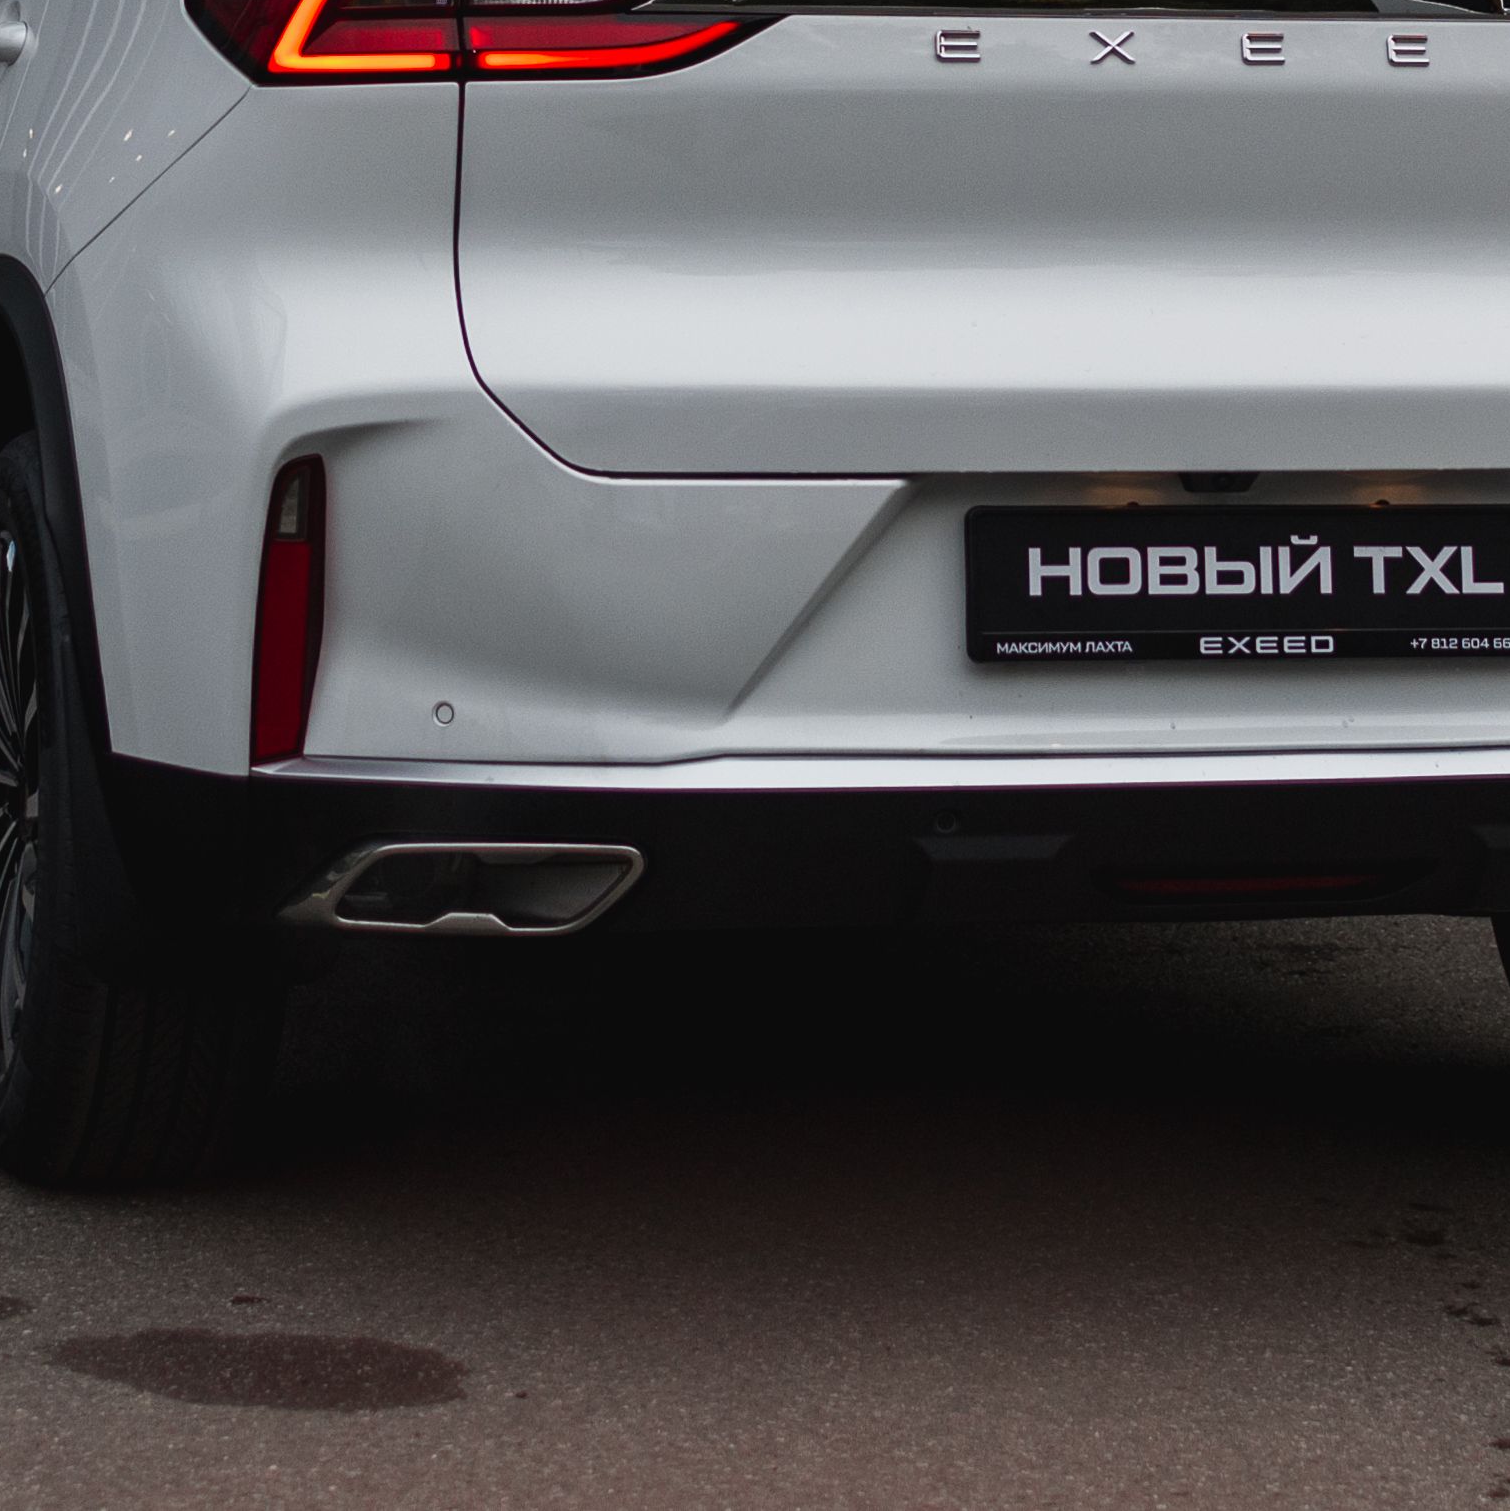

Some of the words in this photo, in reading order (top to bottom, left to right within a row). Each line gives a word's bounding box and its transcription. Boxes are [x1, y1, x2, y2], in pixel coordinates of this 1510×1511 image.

[1028, 534, 1333, 596] НОВЫЙ
[1352, 545, 1506, 594] TXL
[996, 642, 1082, 654] МАКСИМУМ
[1085, 641, 1133, 653] ЛАХТА
[1199, 636, 1334, 654] EXEED
[1410, 637, 1427, 650] +7
[1431, 637, 1458, 650] 812
[1462, 637, 1489, 649] 604
[1493, 637, 1510, 649] 66
